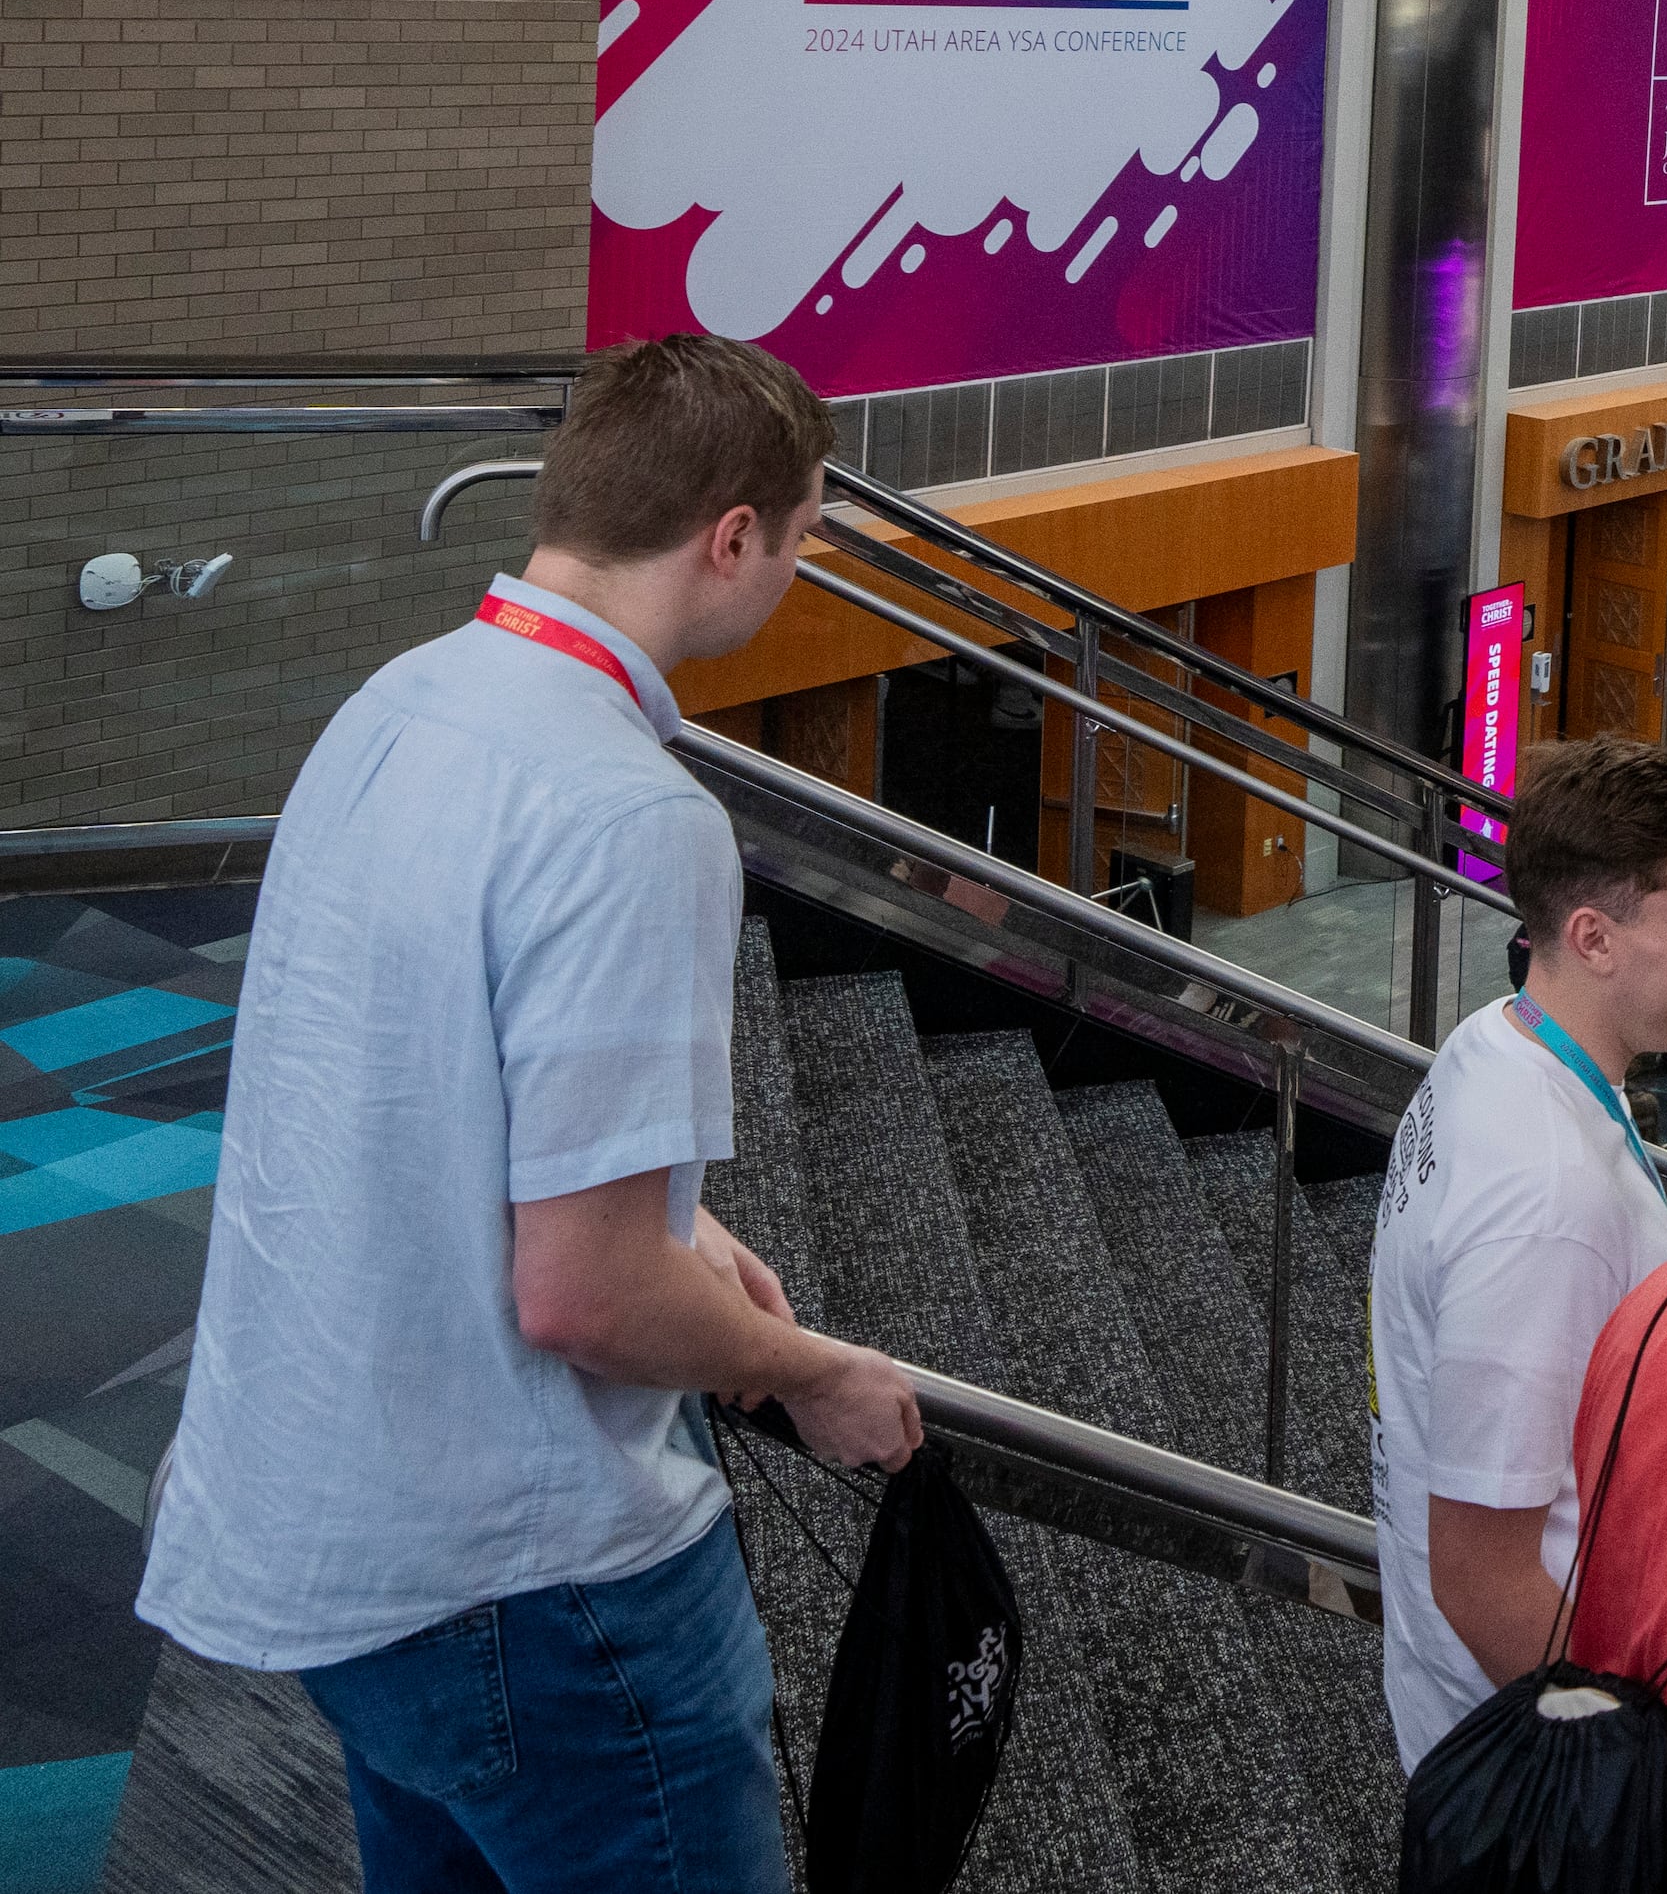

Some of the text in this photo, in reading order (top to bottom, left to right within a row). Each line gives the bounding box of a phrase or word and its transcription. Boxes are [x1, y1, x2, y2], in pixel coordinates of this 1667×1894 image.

[804, 28, 1187, 52] 2024 UTAH AREA YSA CONFERENCE
[495, 612, 541, 637] CHRIST
[1481, 605, 1513, 625] CHRIST
[1483, 643, 1501, 788] SPEED DATING
